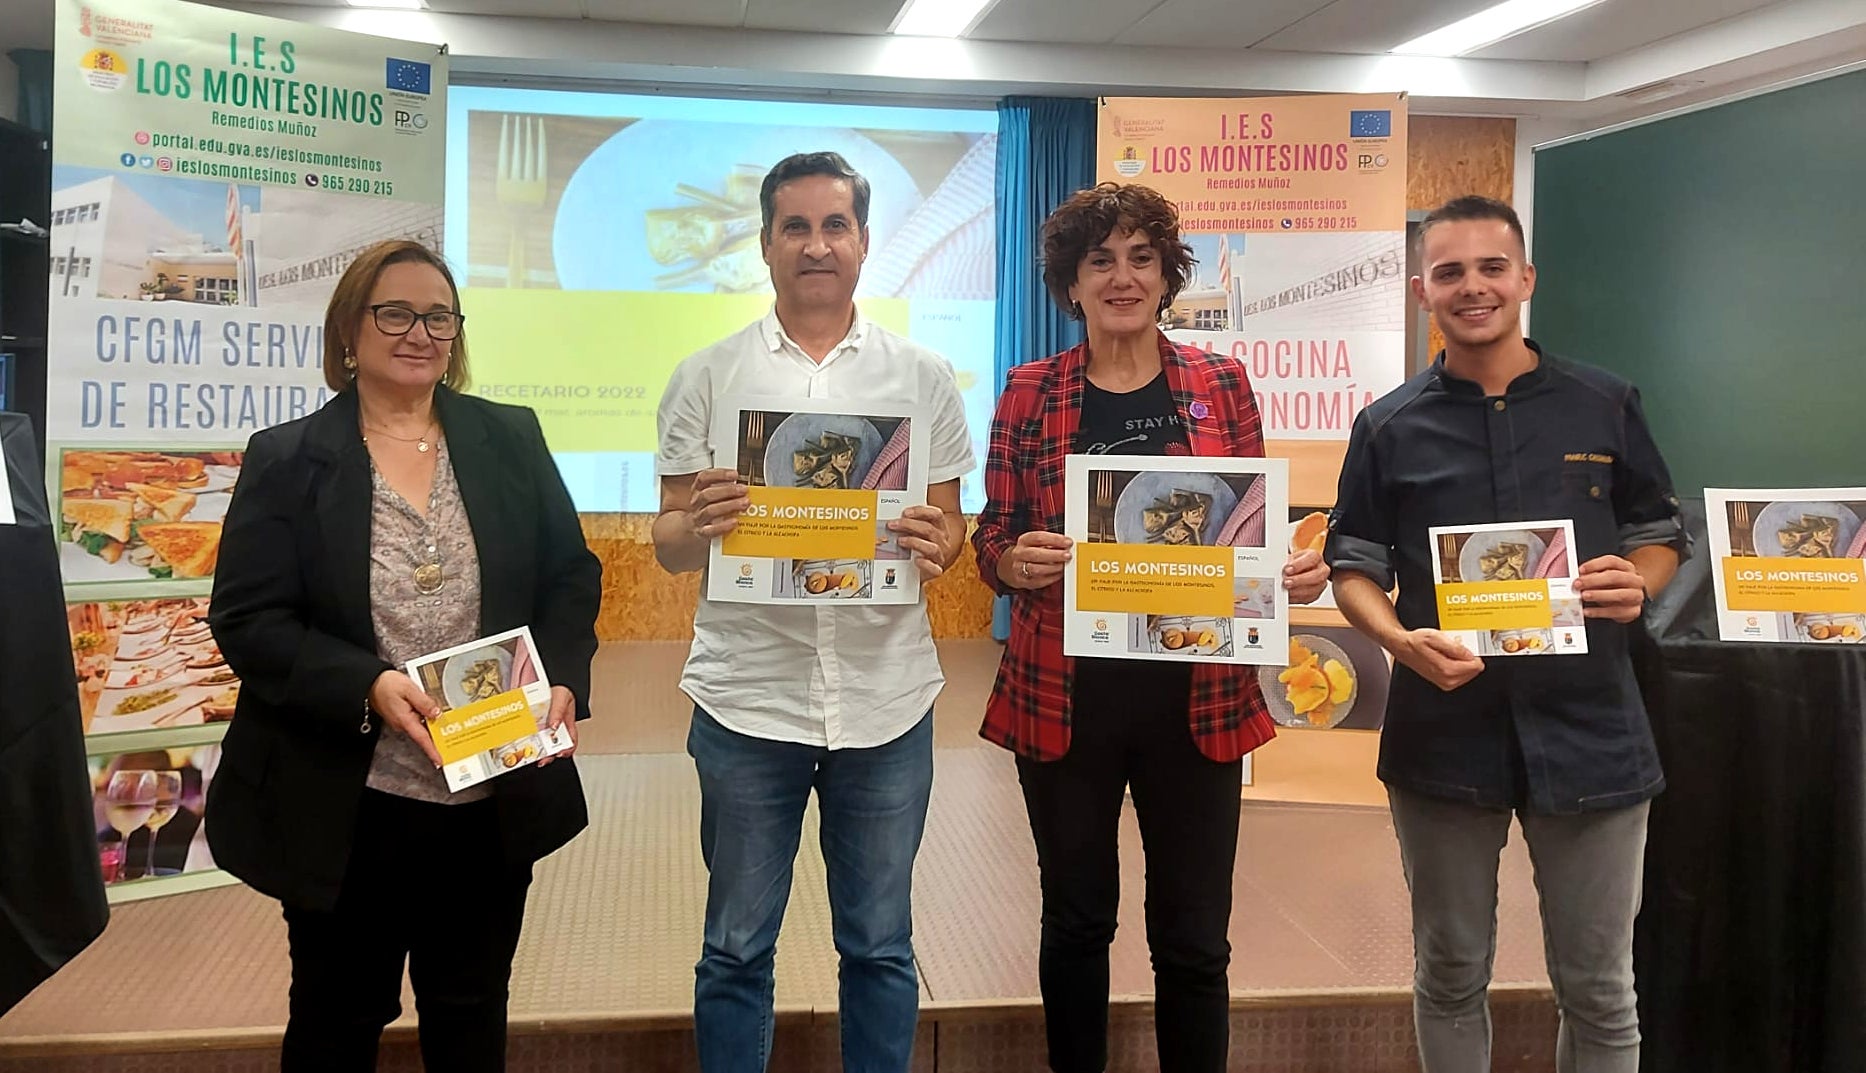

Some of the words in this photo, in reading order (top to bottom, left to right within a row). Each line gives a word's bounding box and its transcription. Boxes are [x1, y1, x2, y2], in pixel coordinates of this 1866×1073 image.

[230, 32, 296, 74] I.E.S
[136, 57, 192, 99] LOS
[203, 67, 384, 127] MONTESINOS
[212, 110, 275, 132] Remedios
[277, 120, 317, 138] Muñoz
[1221, 113, 1274, 141] I.E.S
[152, 131, 383, 173] portal.edu.gva.es/ieslosmontesinos
[1152, 145, 1192, 174] LOS
[1200, 143, 1349, 173] MONTESINOS
[176, 156, 297, 186] ieslosmontesinos
[322, 174, 346, 191] 965
[347, 176, 371, 194] 290
[373, 179, 393, 196] 215
[1207, 178, 1256, 191] Remedios
[1258, 177, 1291, 190] Muñoz
[1177, 199, 1348, 213] rtal.edu.gva.es/ieslosmontesinos
[1295, 217, 1314, 230] 965
[1317, 217, 1336, 230] 290
[1340, 216, 1357, 229] 215
[96, 315, 202, 366] CFGM
[222, 320, 323, 369] SERVI
[1231, 339, 1352, 379] COCINA
[81, 380, 127, 430] DE
[147, 381, 328, 431] RESTAURA
[479, 384, 590, 399] RECETARIO
[596, 385, 646, 399] 2022
[1124, 416, 1163, 430] STAY
[771, 505, 870, 521] MONTESINOS
[1090, 560, 1120, 574] LOS
[1124, 562, 1226, 578] MONTESINOS
[1736, 570, 1763, 581] LOS
[1767, 571, 1859, 583] MONTESINOS
[1446, 594, 1468, 605] LOS
[1470, 591, 1544, 604] MONTESINOS
[441, 722, 462, 737] LOS
[463, 700, 524, 729] MONTESINOS
